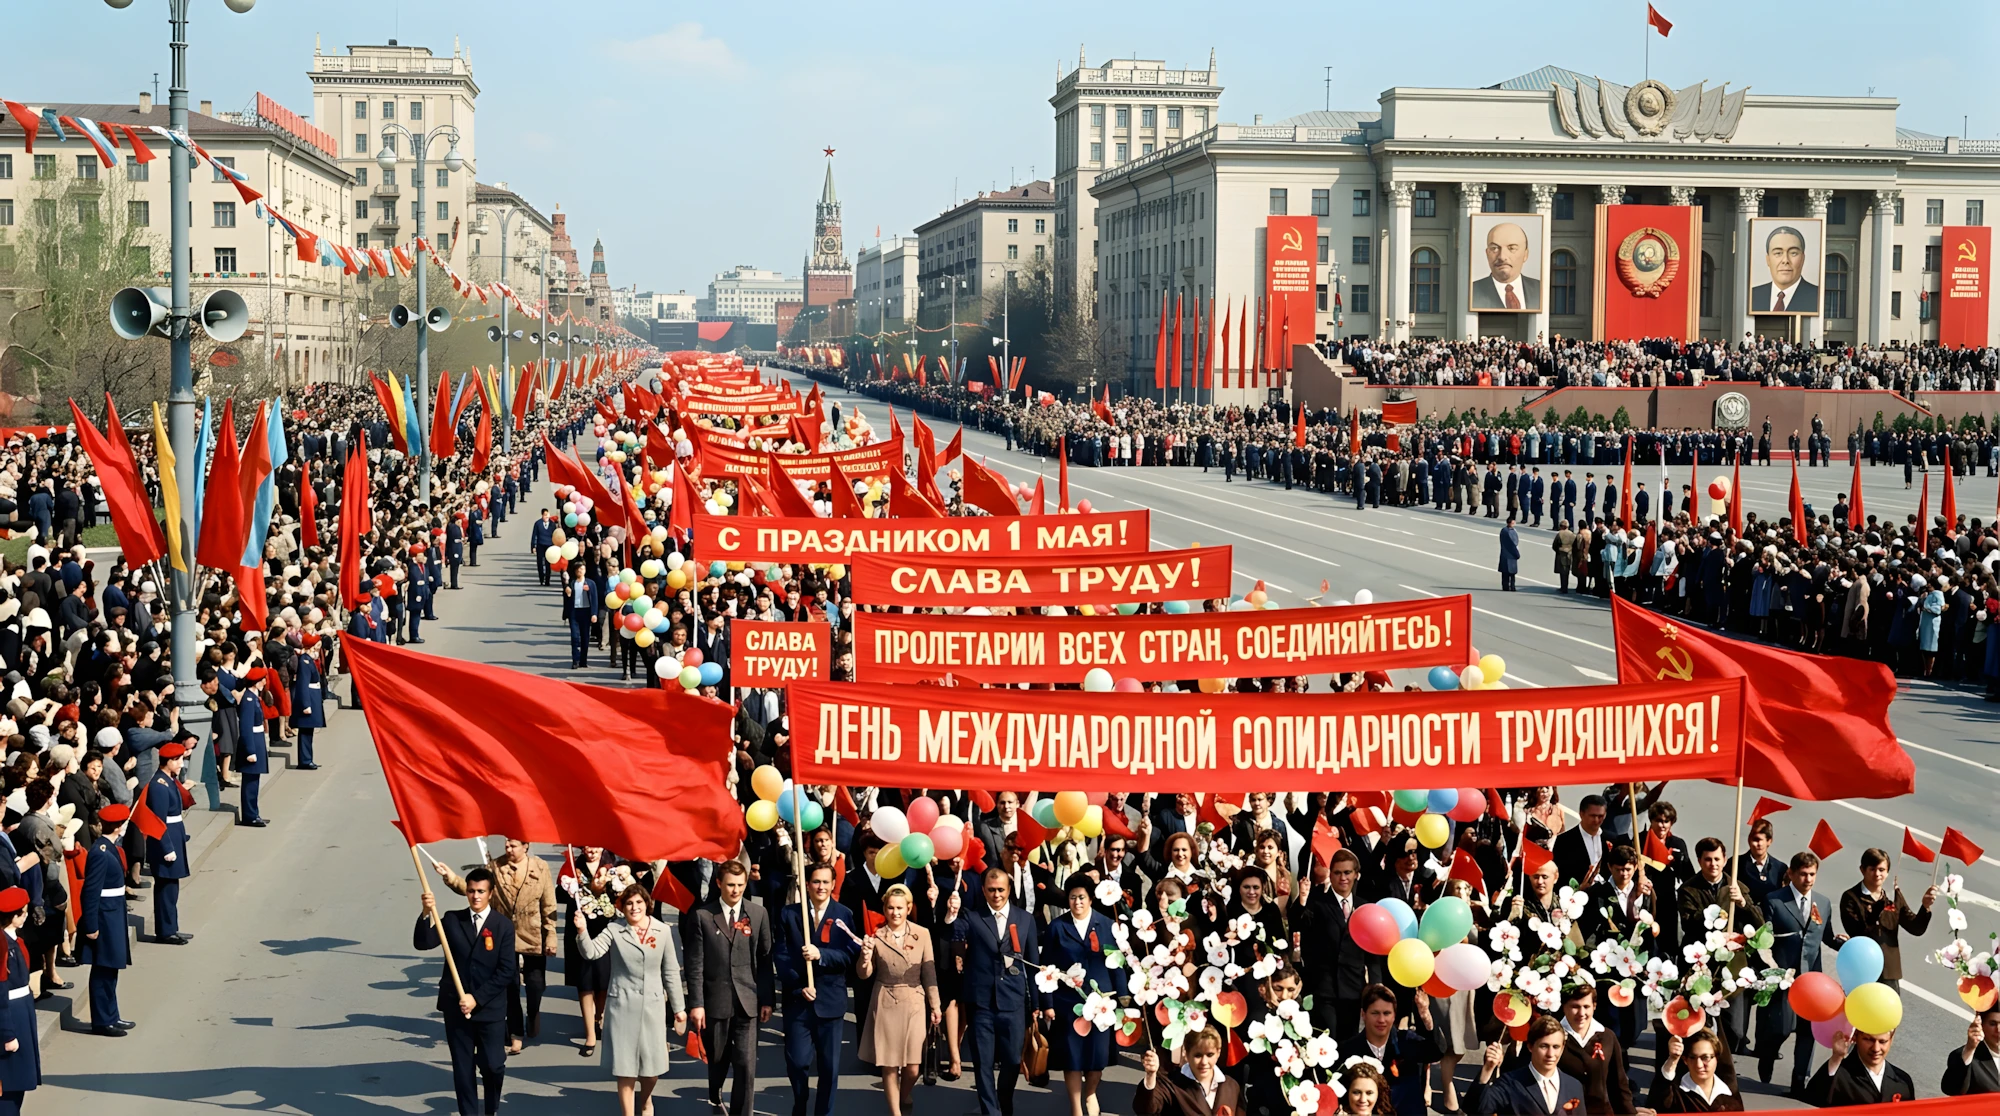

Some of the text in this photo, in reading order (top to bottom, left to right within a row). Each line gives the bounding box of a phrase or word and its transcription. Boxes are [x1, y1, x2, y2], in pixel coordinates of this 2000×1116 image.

[717, 519, 1128, 556] С ПРАЗДНИКОМ 1 МАЯ!
[890, 557, 1201, 595] СЛАВА ТРУДУ!
[745, 629, 817, 652] СЛАВА
[874, 609, 1453, 666] ПРОЛЕТАРИИ ВСЕХ СТРАН, СОЕДИНЯЙТЕСЬ!
[743, 655, 818, 681] ТРУДУ!
[814, 694, 1721, 776] ДЕНЬ МЕЖДУНАРОДНОЙ СОЛИДАРНОСТИ ТРУДЯЩИХСЯ!
